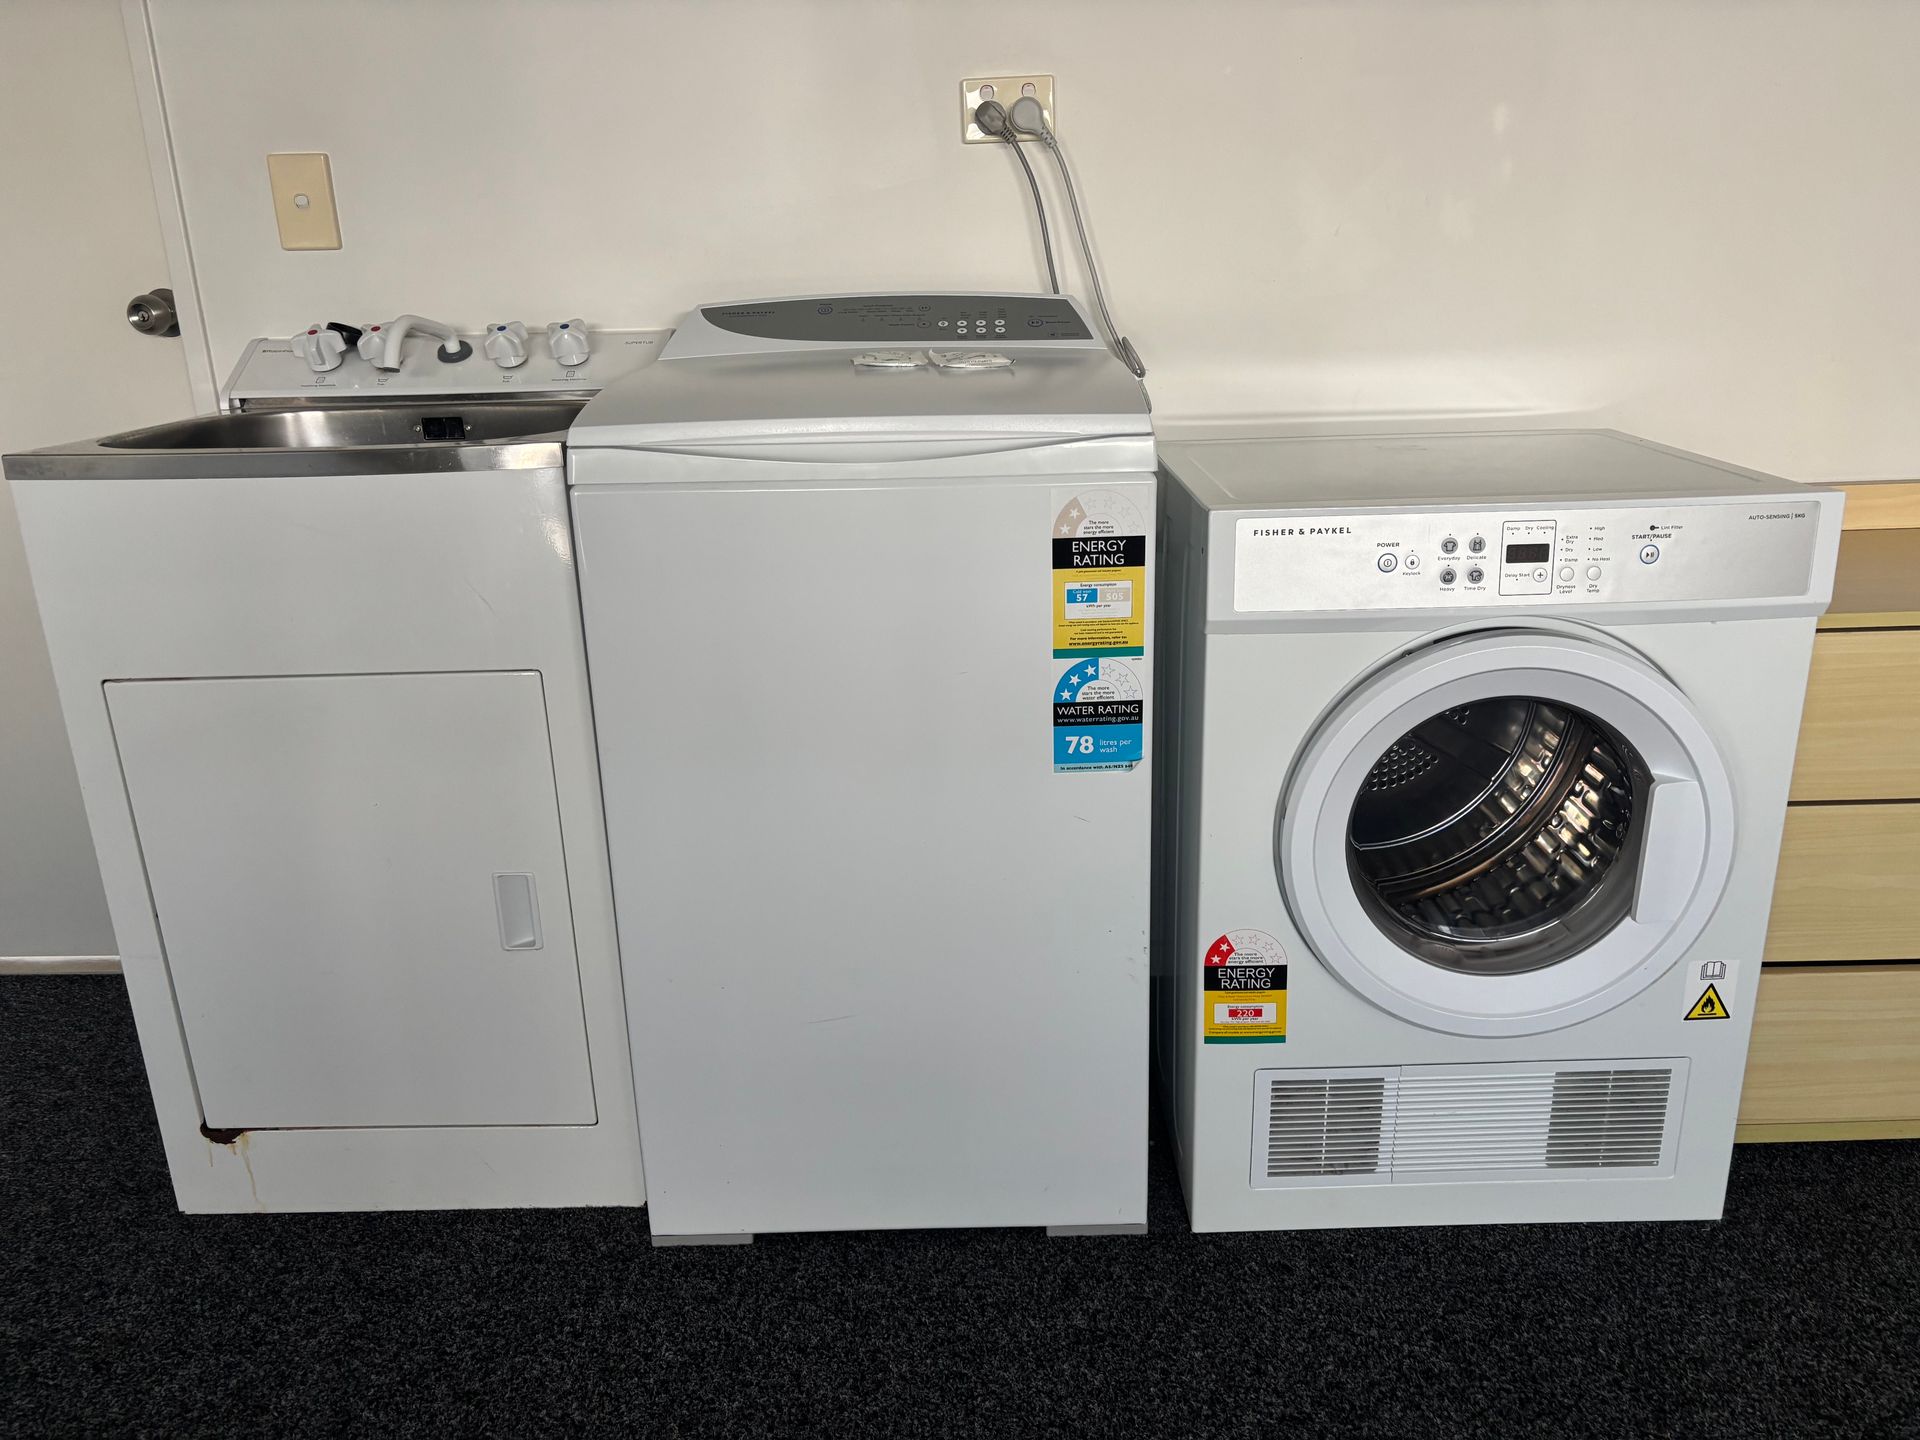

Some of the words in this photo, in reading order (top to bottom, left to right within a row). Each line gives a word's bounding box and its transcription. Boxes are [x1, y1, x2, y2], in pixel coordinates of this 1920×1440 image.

[1253, 528, 1294, 537] FISHER
[1309, 526, 1352, 535] PAYKEL
[1072, 539, 1127, 553] ENERGY
[1073, 553, 1125, 566] RATING
[1076, 593, 1088, 602] 57
[1106, 592, 1124, 601] 505
[1057, 706, 1095, 716] WATER
[1098, 704, 1139, 714] RATING
[1065, 735, 1094, 754] 78
[1218, 967, 1275, 979] ENERGY
[1221, 978, 1271, 989] RATING
[1236, 1009, 1255, 1017] 220
